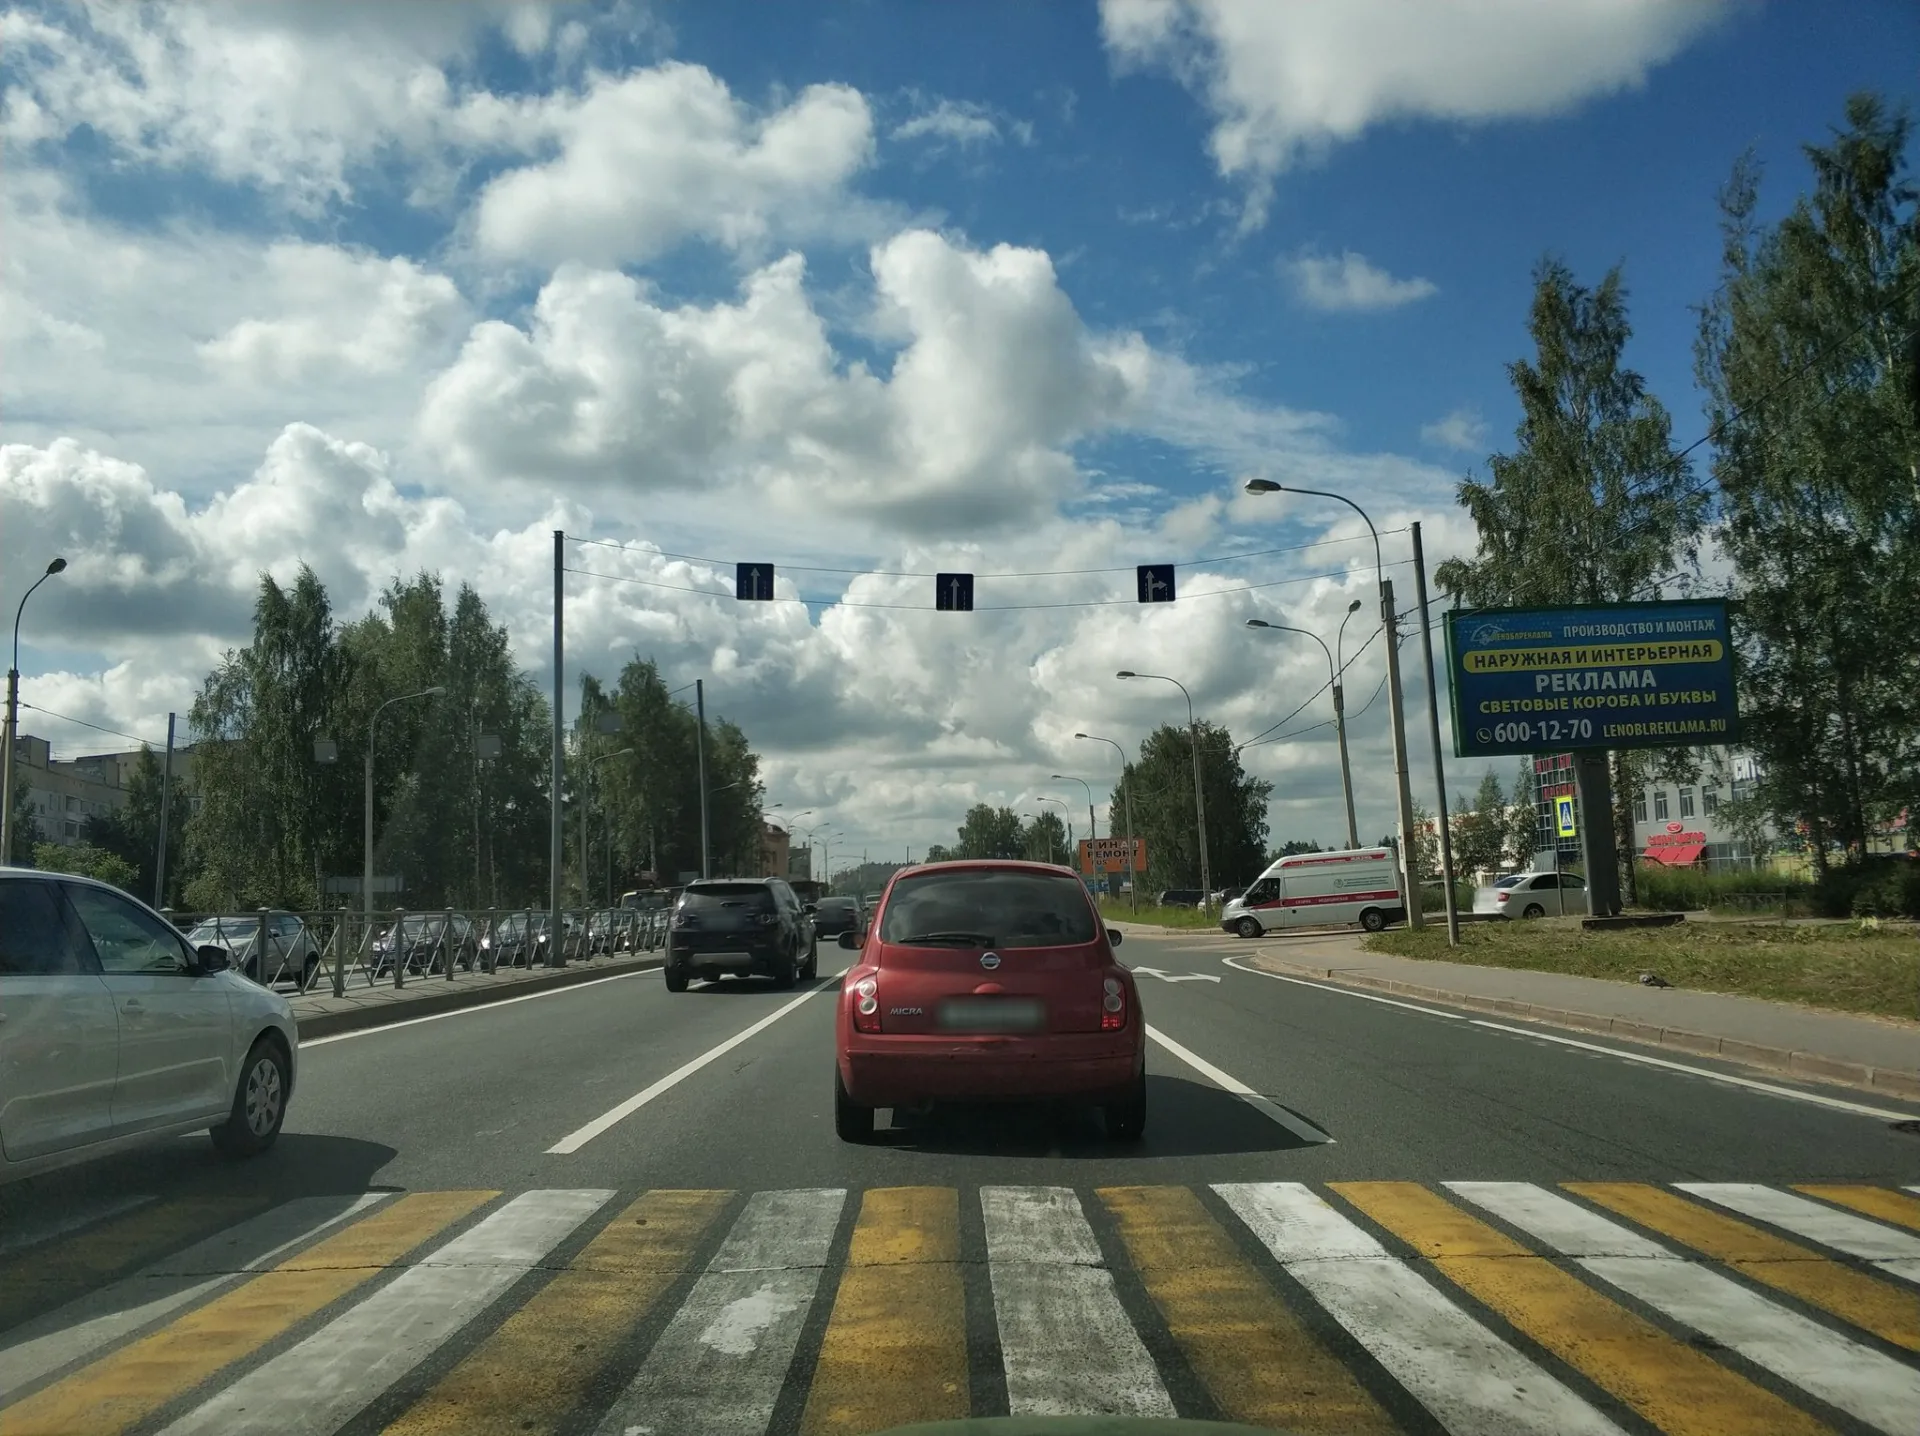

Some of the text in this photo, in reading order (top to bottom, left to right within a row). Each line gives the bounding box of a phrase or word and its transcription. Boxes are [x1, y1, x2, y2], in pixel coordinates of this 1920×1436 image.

[1563, 619, 1716, 638] ПРОИЗВОДСТВО И МОНТАЖ
[1474, 644, 1713, 668] НАРУЖНАЯ И ИНТЕРЬЕРНАЯ
[1535, 670, 1657, 692] РЕКЛАМА
[1479, 690, 1717, 714] СВЕТОВЫЕ КОРОБА И БУКВЫ
[1494, 719, 1592, 743] 600-12-70
[1603, 719, 1726, 738] LENOBLREKLAMA.RU
